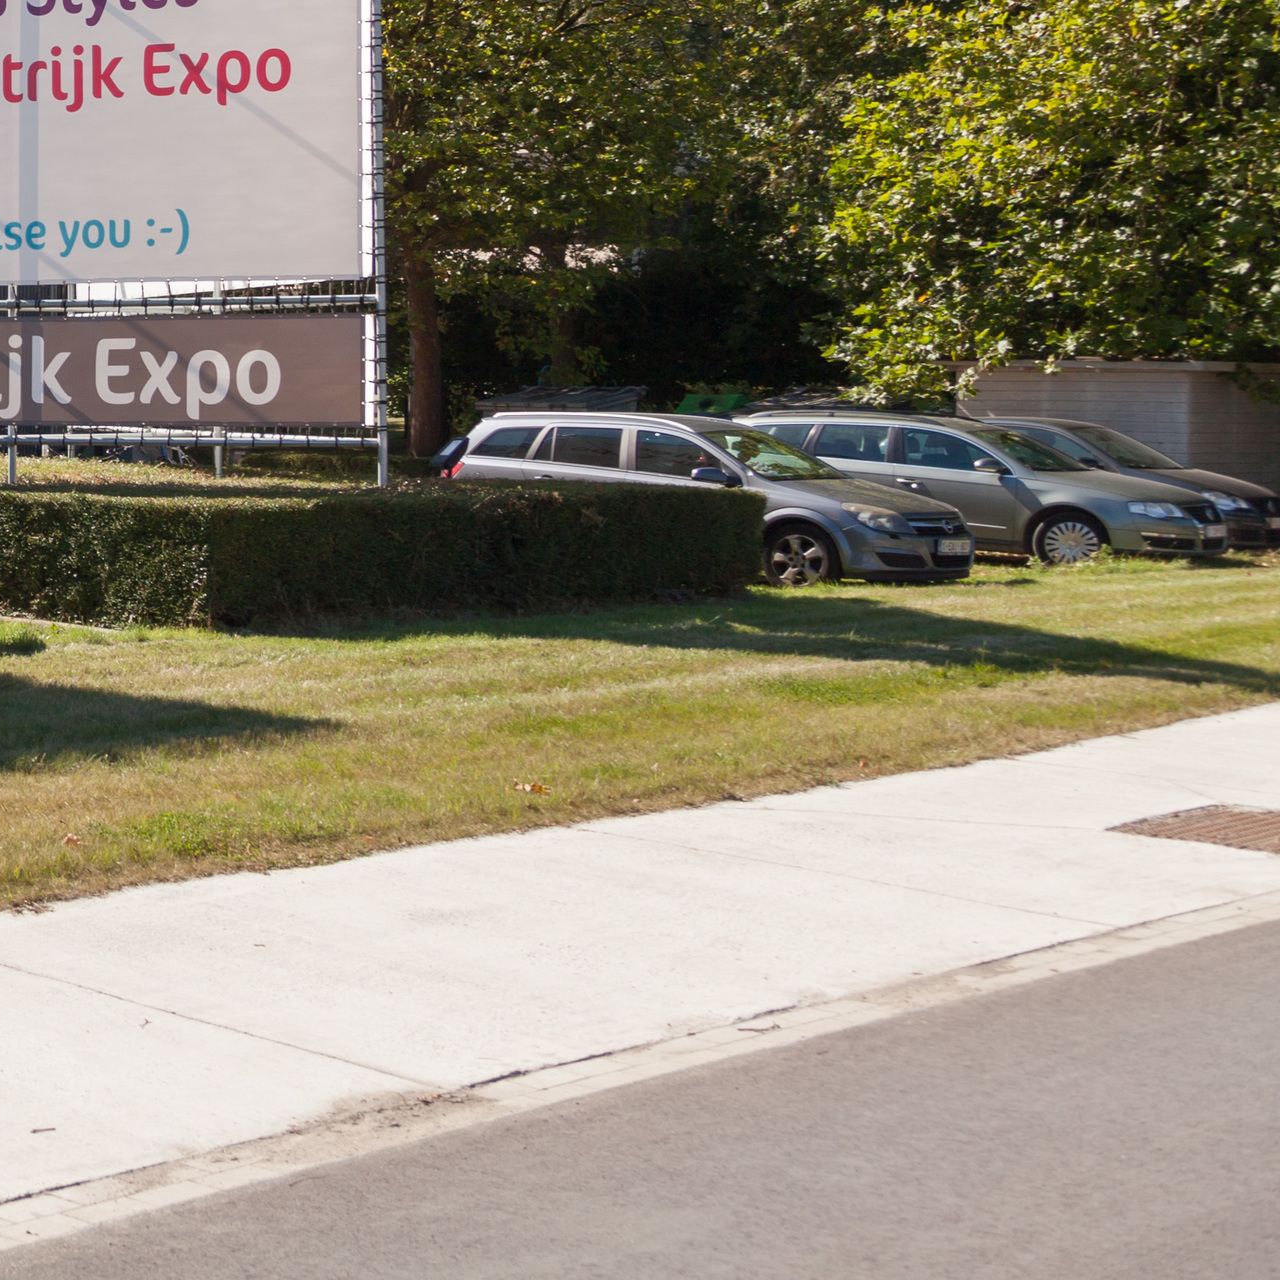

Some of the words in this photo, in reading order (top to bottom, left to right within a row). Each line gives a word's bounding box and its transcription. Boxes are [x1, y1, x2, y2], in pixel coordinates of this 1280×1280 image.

[142, 43, 292, 107] Expo
[57, 217, 132, 258] you
[145, 207, 191, 256] :-)
[95, 336, 282, 420] Expo
